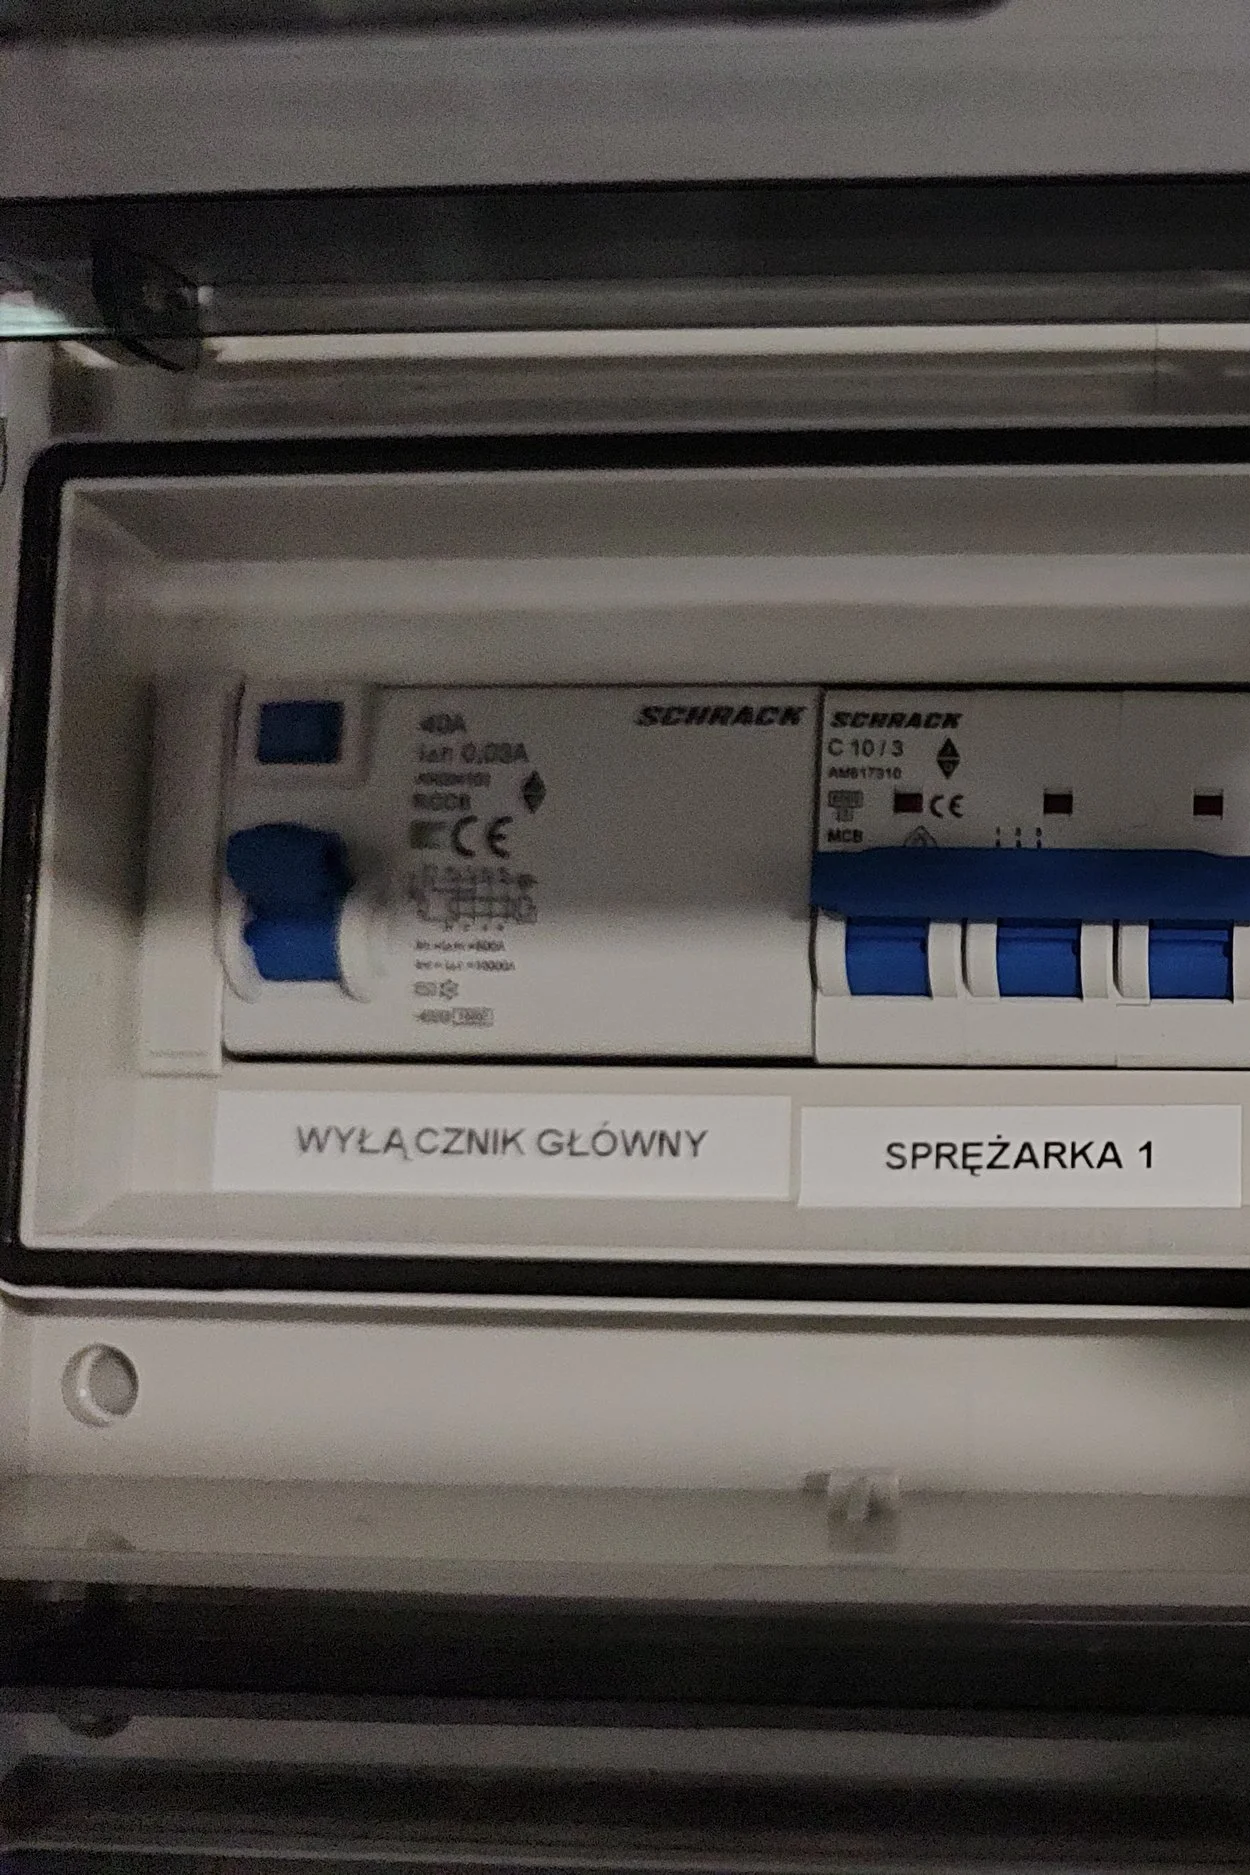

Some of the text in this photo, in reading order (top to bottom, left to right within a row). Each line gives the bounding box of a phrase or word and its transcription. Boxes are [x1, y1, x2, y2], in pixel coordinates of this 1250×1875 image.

[636, 705, 807, 726] SCHRACK
[829, 711, 964, 728] SCHRACK
[929, 794, 964, 819] CE
[450, 814, 514, 858] CE
[828, 829, 864, 843] MCB
[298, 1121, 709, 1160] WYŁĄCZNIK GŁÓWNY
[885, 1134, 1152, 1176] SPRĘŻARKA 1
